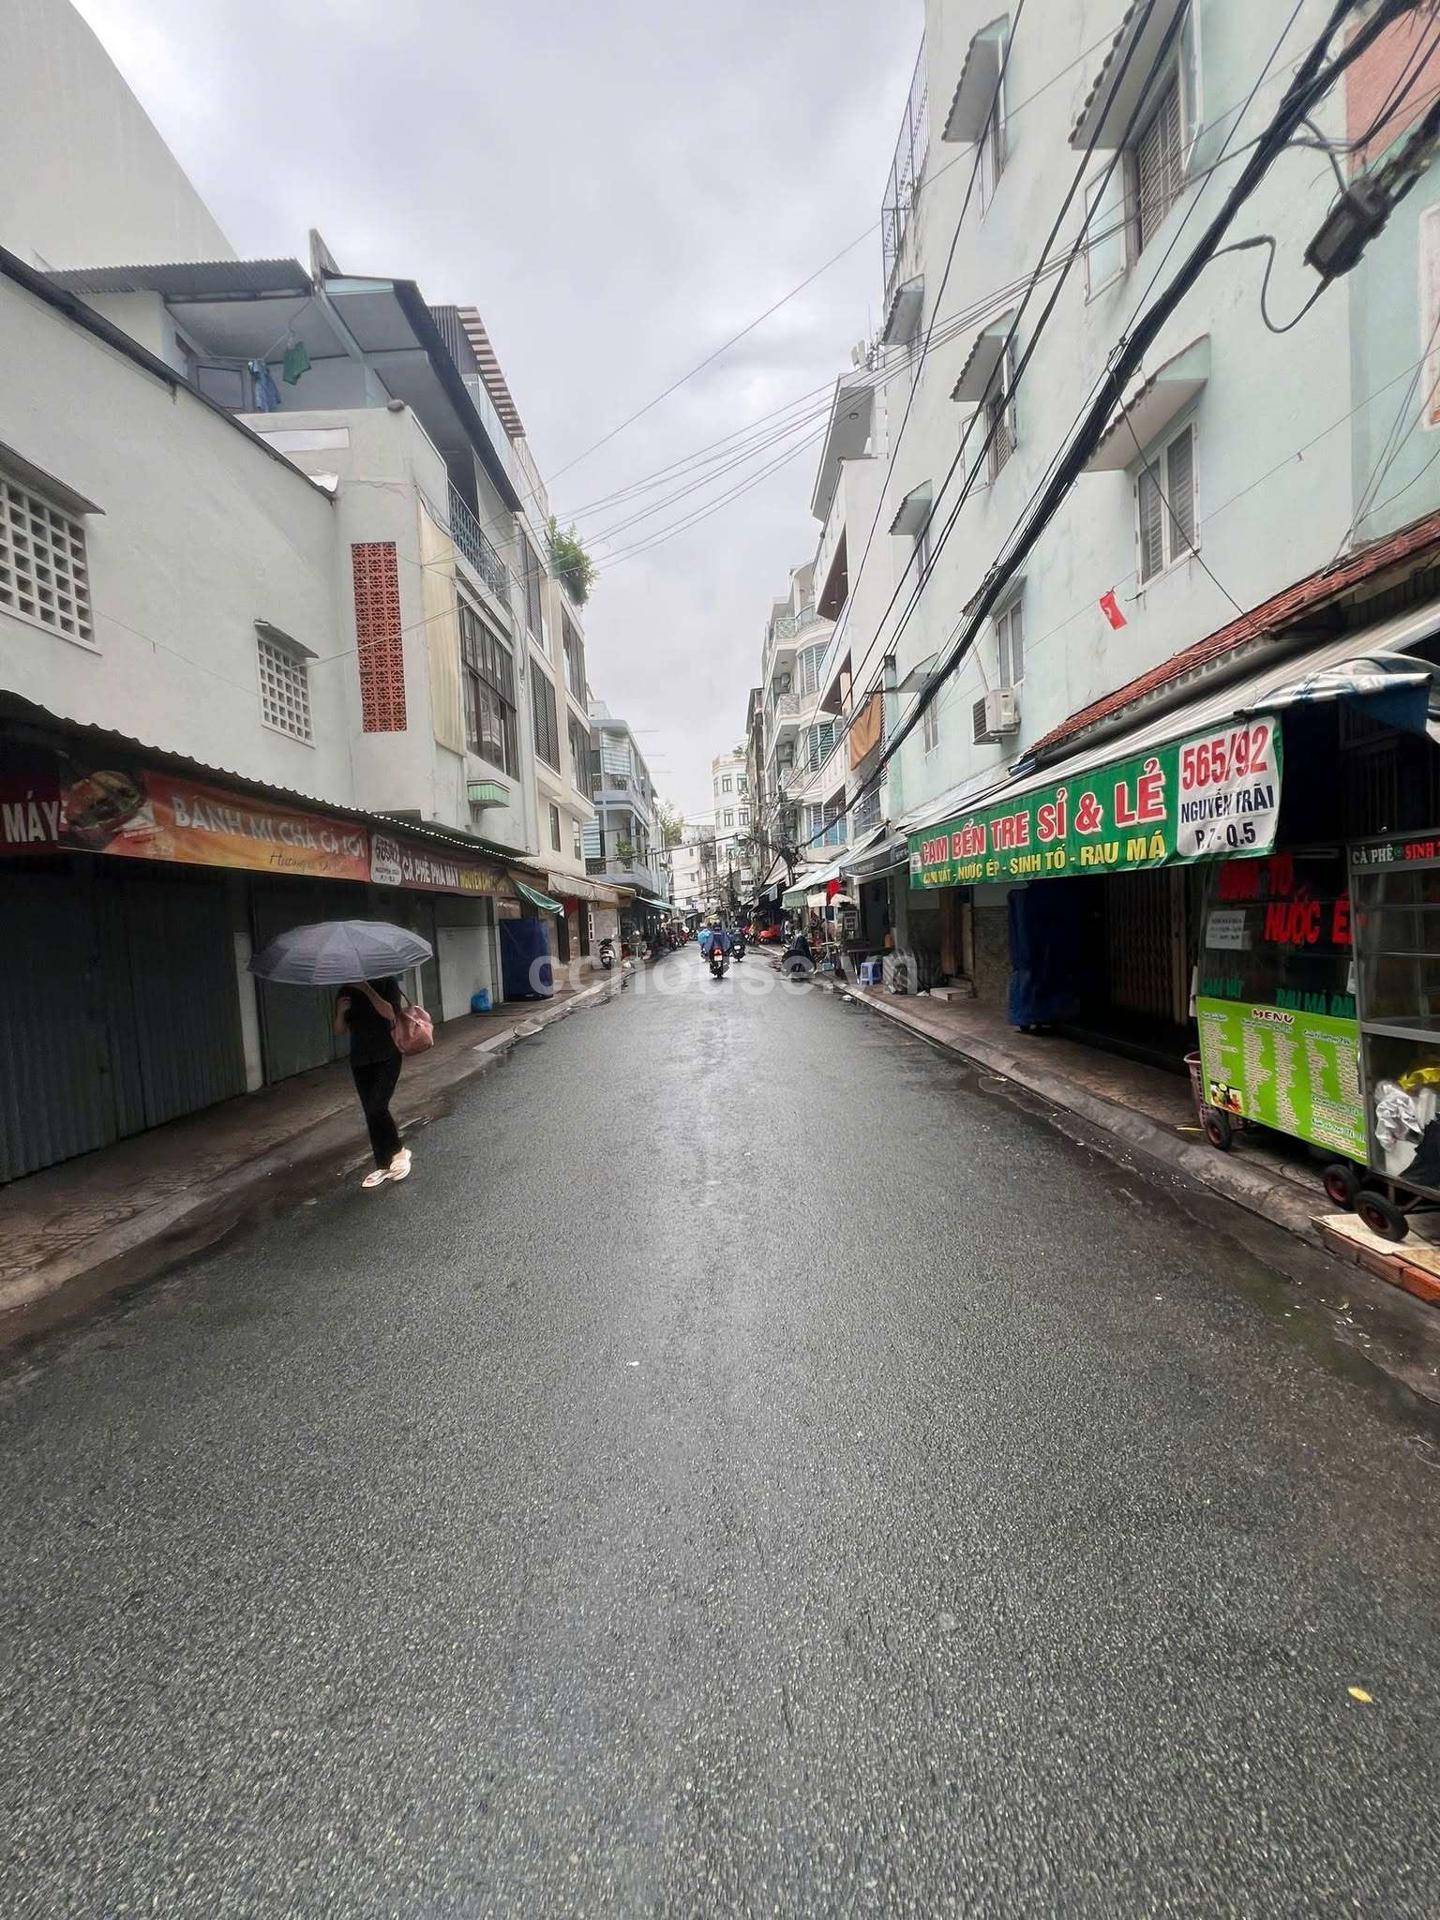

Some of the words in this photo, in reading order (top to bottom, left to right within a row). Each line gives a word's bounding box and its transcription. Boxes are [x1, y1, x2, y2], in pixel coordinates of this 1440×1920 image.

[1181, 725, 1269, 790] 565/92
[2, 789, 60, 843] MÁY
[921, 834, 949, 866] CAM
[951, 818, 987, 860] BẾN
[989, 809, 1030, 852] TRE
[1036, 786, 1069, 843] SỈ
[1075, 791, 1103, 835] &
[1114, 757, 1167, 829] LẺ
[1236, 783, 1275, 814] TRÃI
[1009, 854, 1041, 875] SINH
[1045, 843, 1066, 870] TỐ
[1080, 841, 1119, 866] RAU
[1126, 829, 1166, 862] MÁ
[1370, 843, 1395, 864] PHÊ
[1404, 841, 1435, 861] SINH
[1252, 1008, 1296, 1025] MENU
